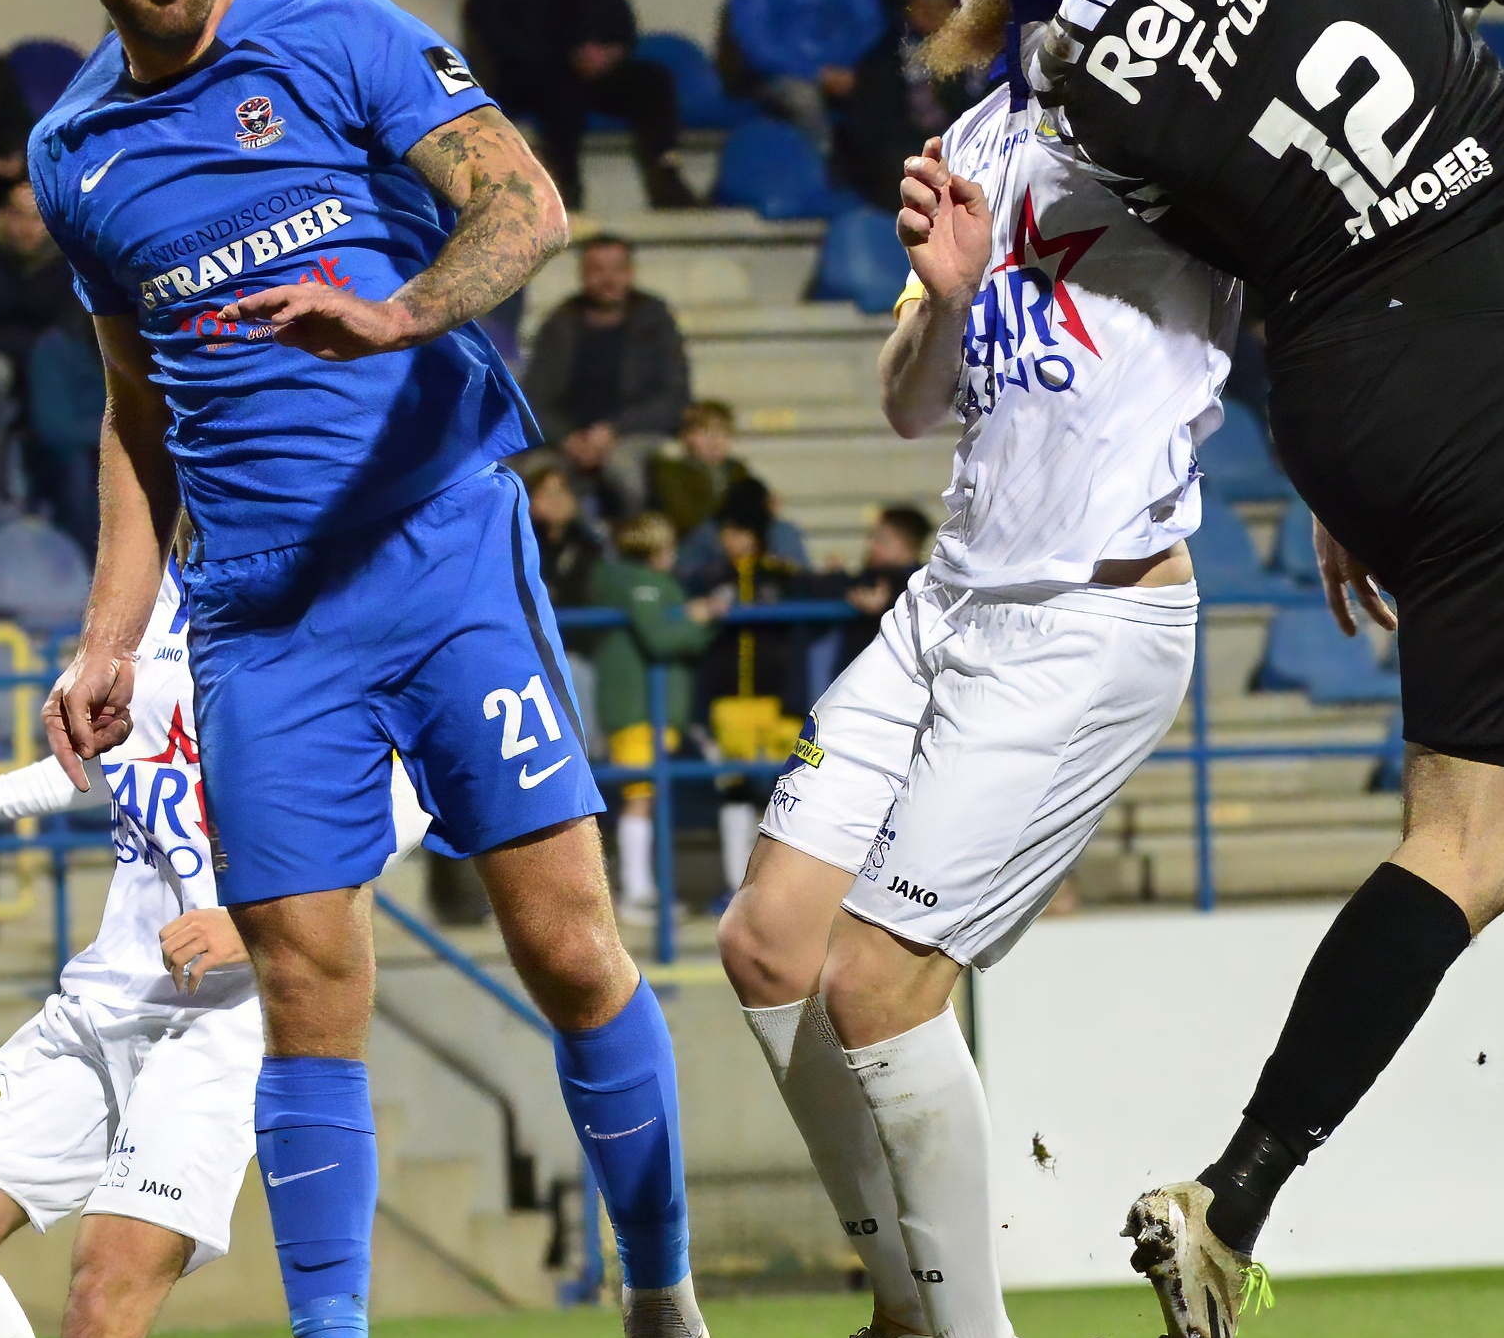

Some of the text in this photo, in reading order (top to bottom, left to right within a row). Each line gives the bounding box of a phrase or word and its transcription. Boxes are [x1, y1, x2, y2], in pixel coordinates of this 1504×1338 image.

[1248, 20, 1437, 216] 12
[1377, 136, 1490, 228] MOER
[140, 196, 353, 311] STRAVBIER
[483, 674, 562, 761] 21
[887, 875, 938, 908] JAKO
[138, 1179, 183, 1201] JAKO
